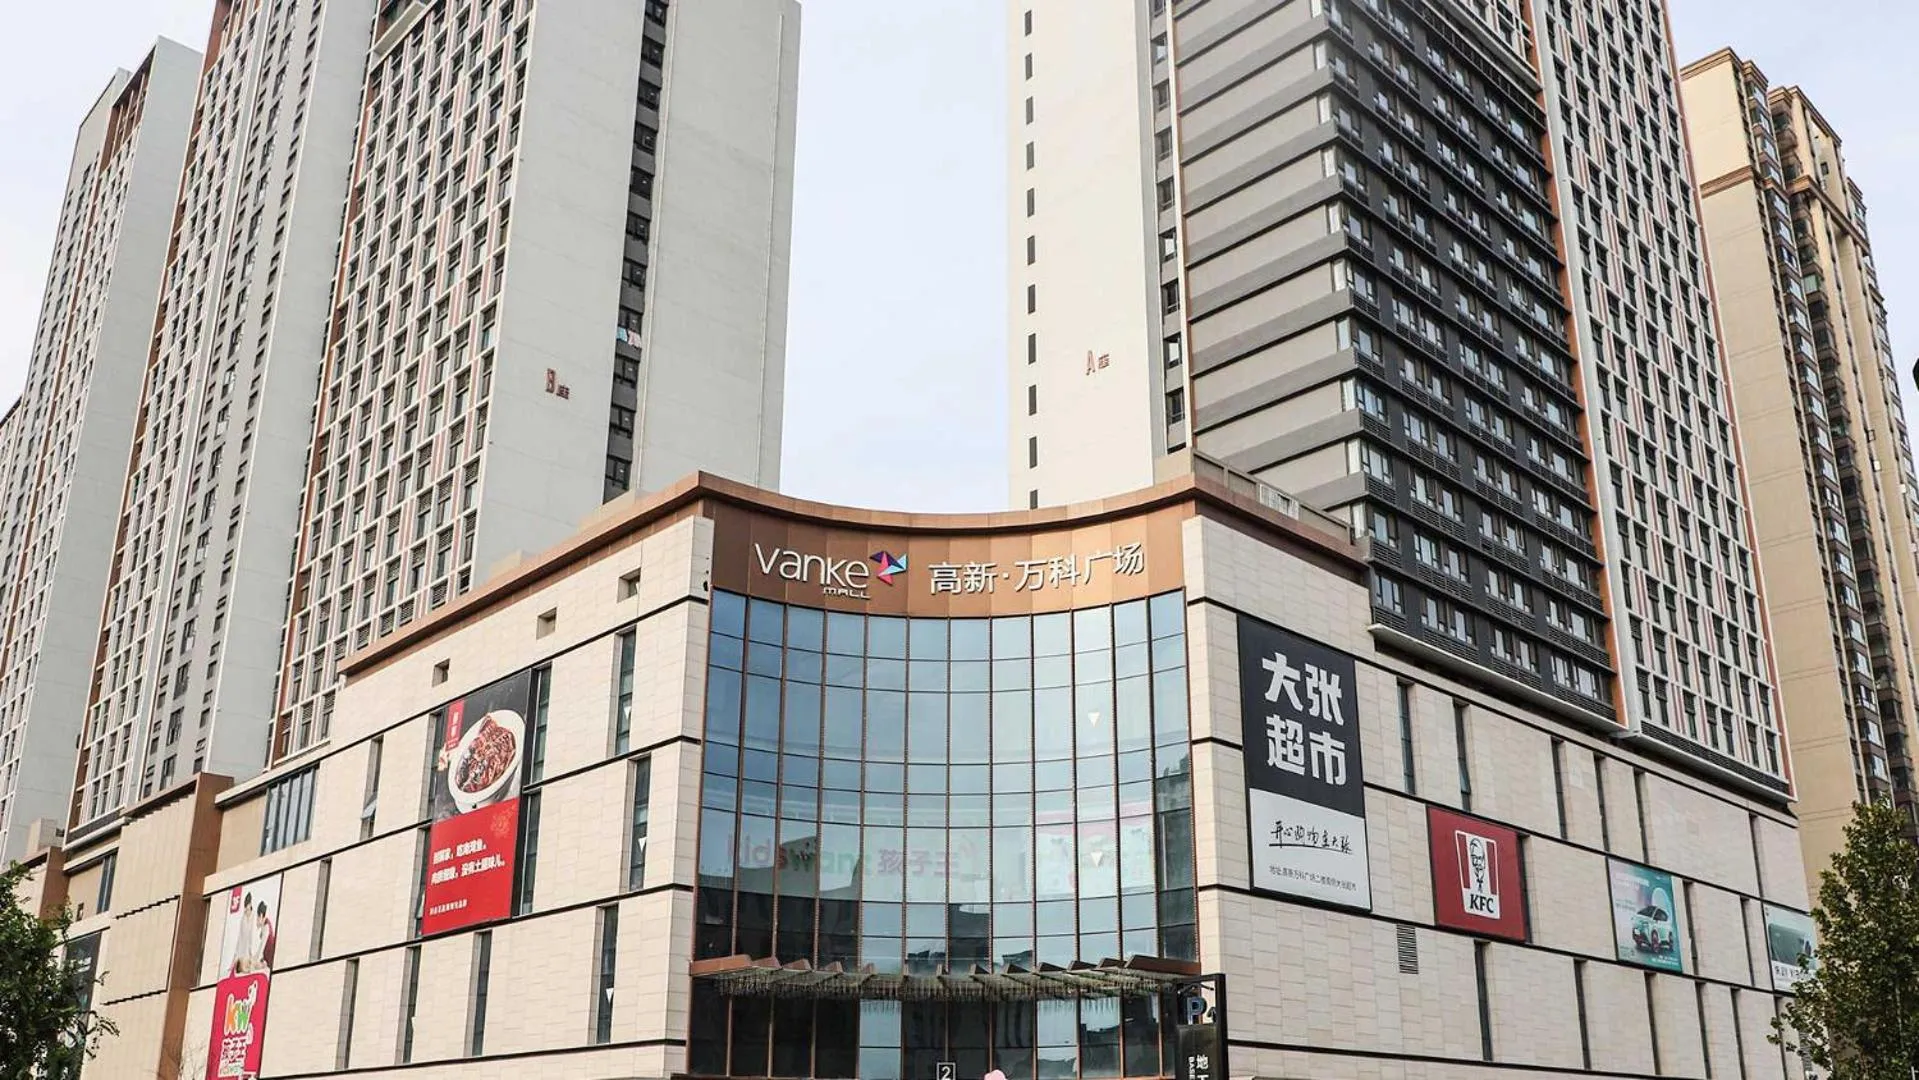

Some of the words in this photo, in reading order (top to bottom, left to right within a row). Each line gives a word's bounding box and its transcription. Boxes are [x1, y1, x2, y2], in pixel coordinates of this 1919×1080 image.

[928, 542, 1146, 595] 高新·万科广场
[1261, 652, 1344, 726] 大张
[1266, 714, 1347, 786] 超市
[1469, 893, 1494, 914] KFC
[1186, 997, 1207, 1025] P
[941, 1065, 951, 1080] 2
